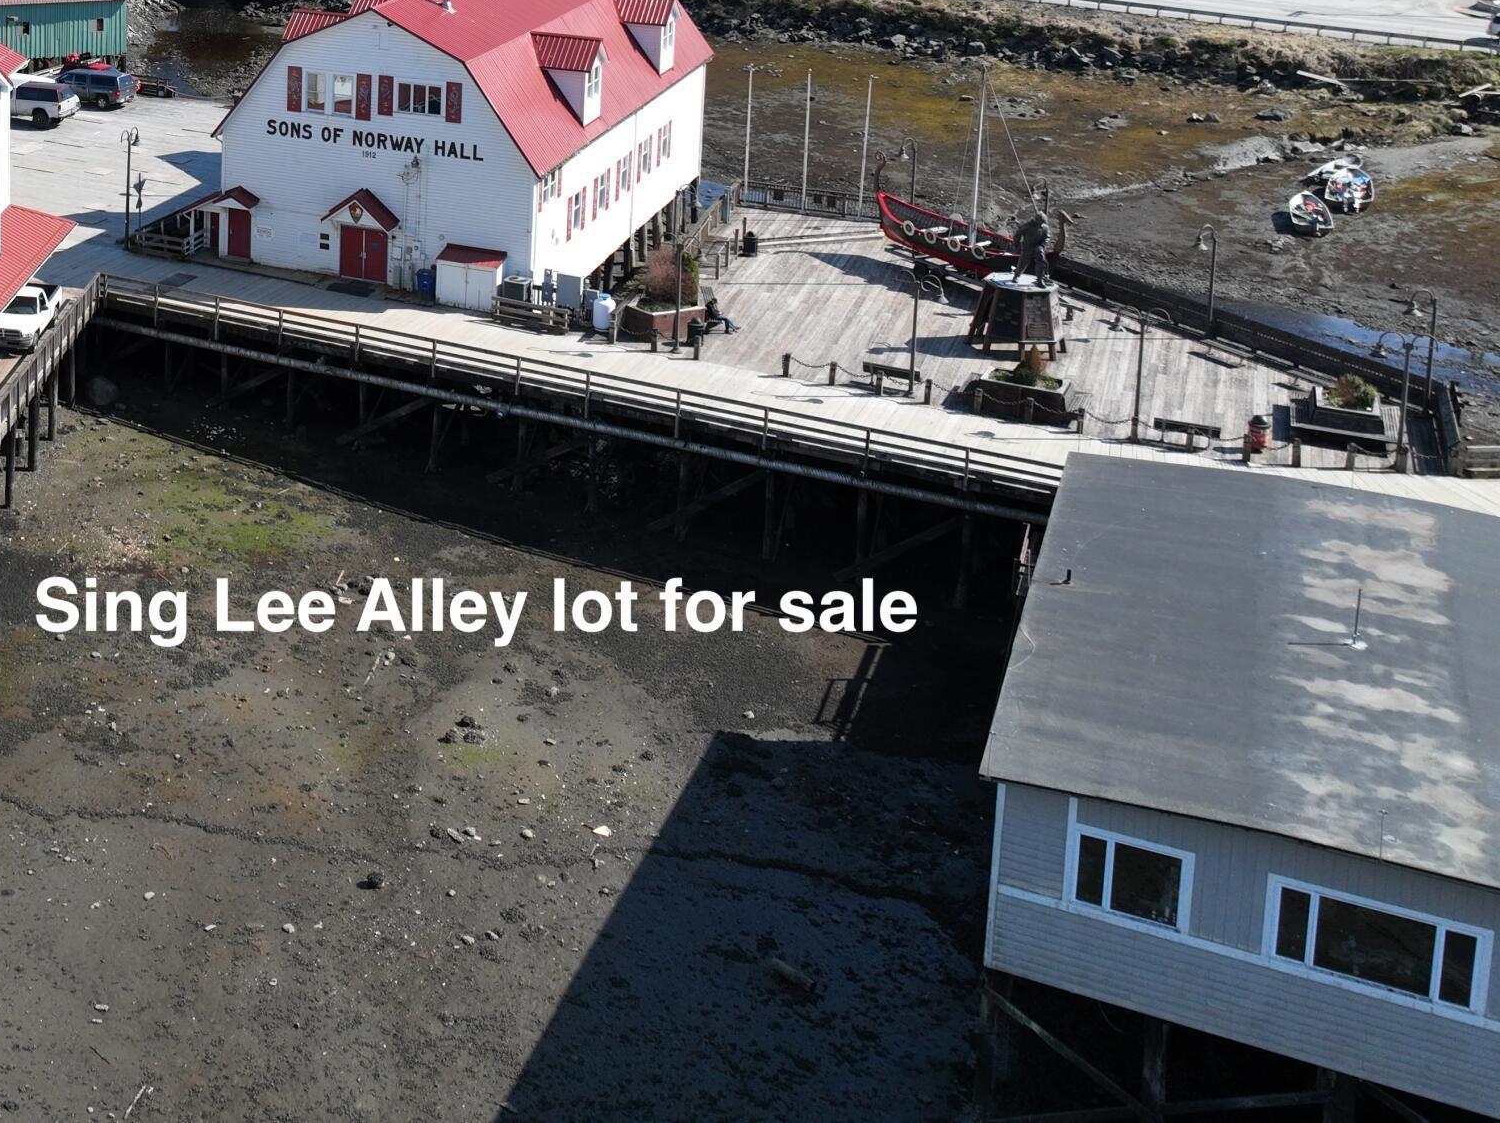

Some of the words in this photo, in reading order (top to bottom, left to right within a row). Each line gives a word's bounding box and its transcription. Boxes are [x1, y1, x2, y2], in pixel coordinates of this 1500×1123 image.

[266, 119, 313, 140] SONS
[321, 126, 344, 144] OF
[352, 130, 425, 154] NORWAY
[434, 139, 484, 162] HALL
[361, 150, 377, 159] 1912
